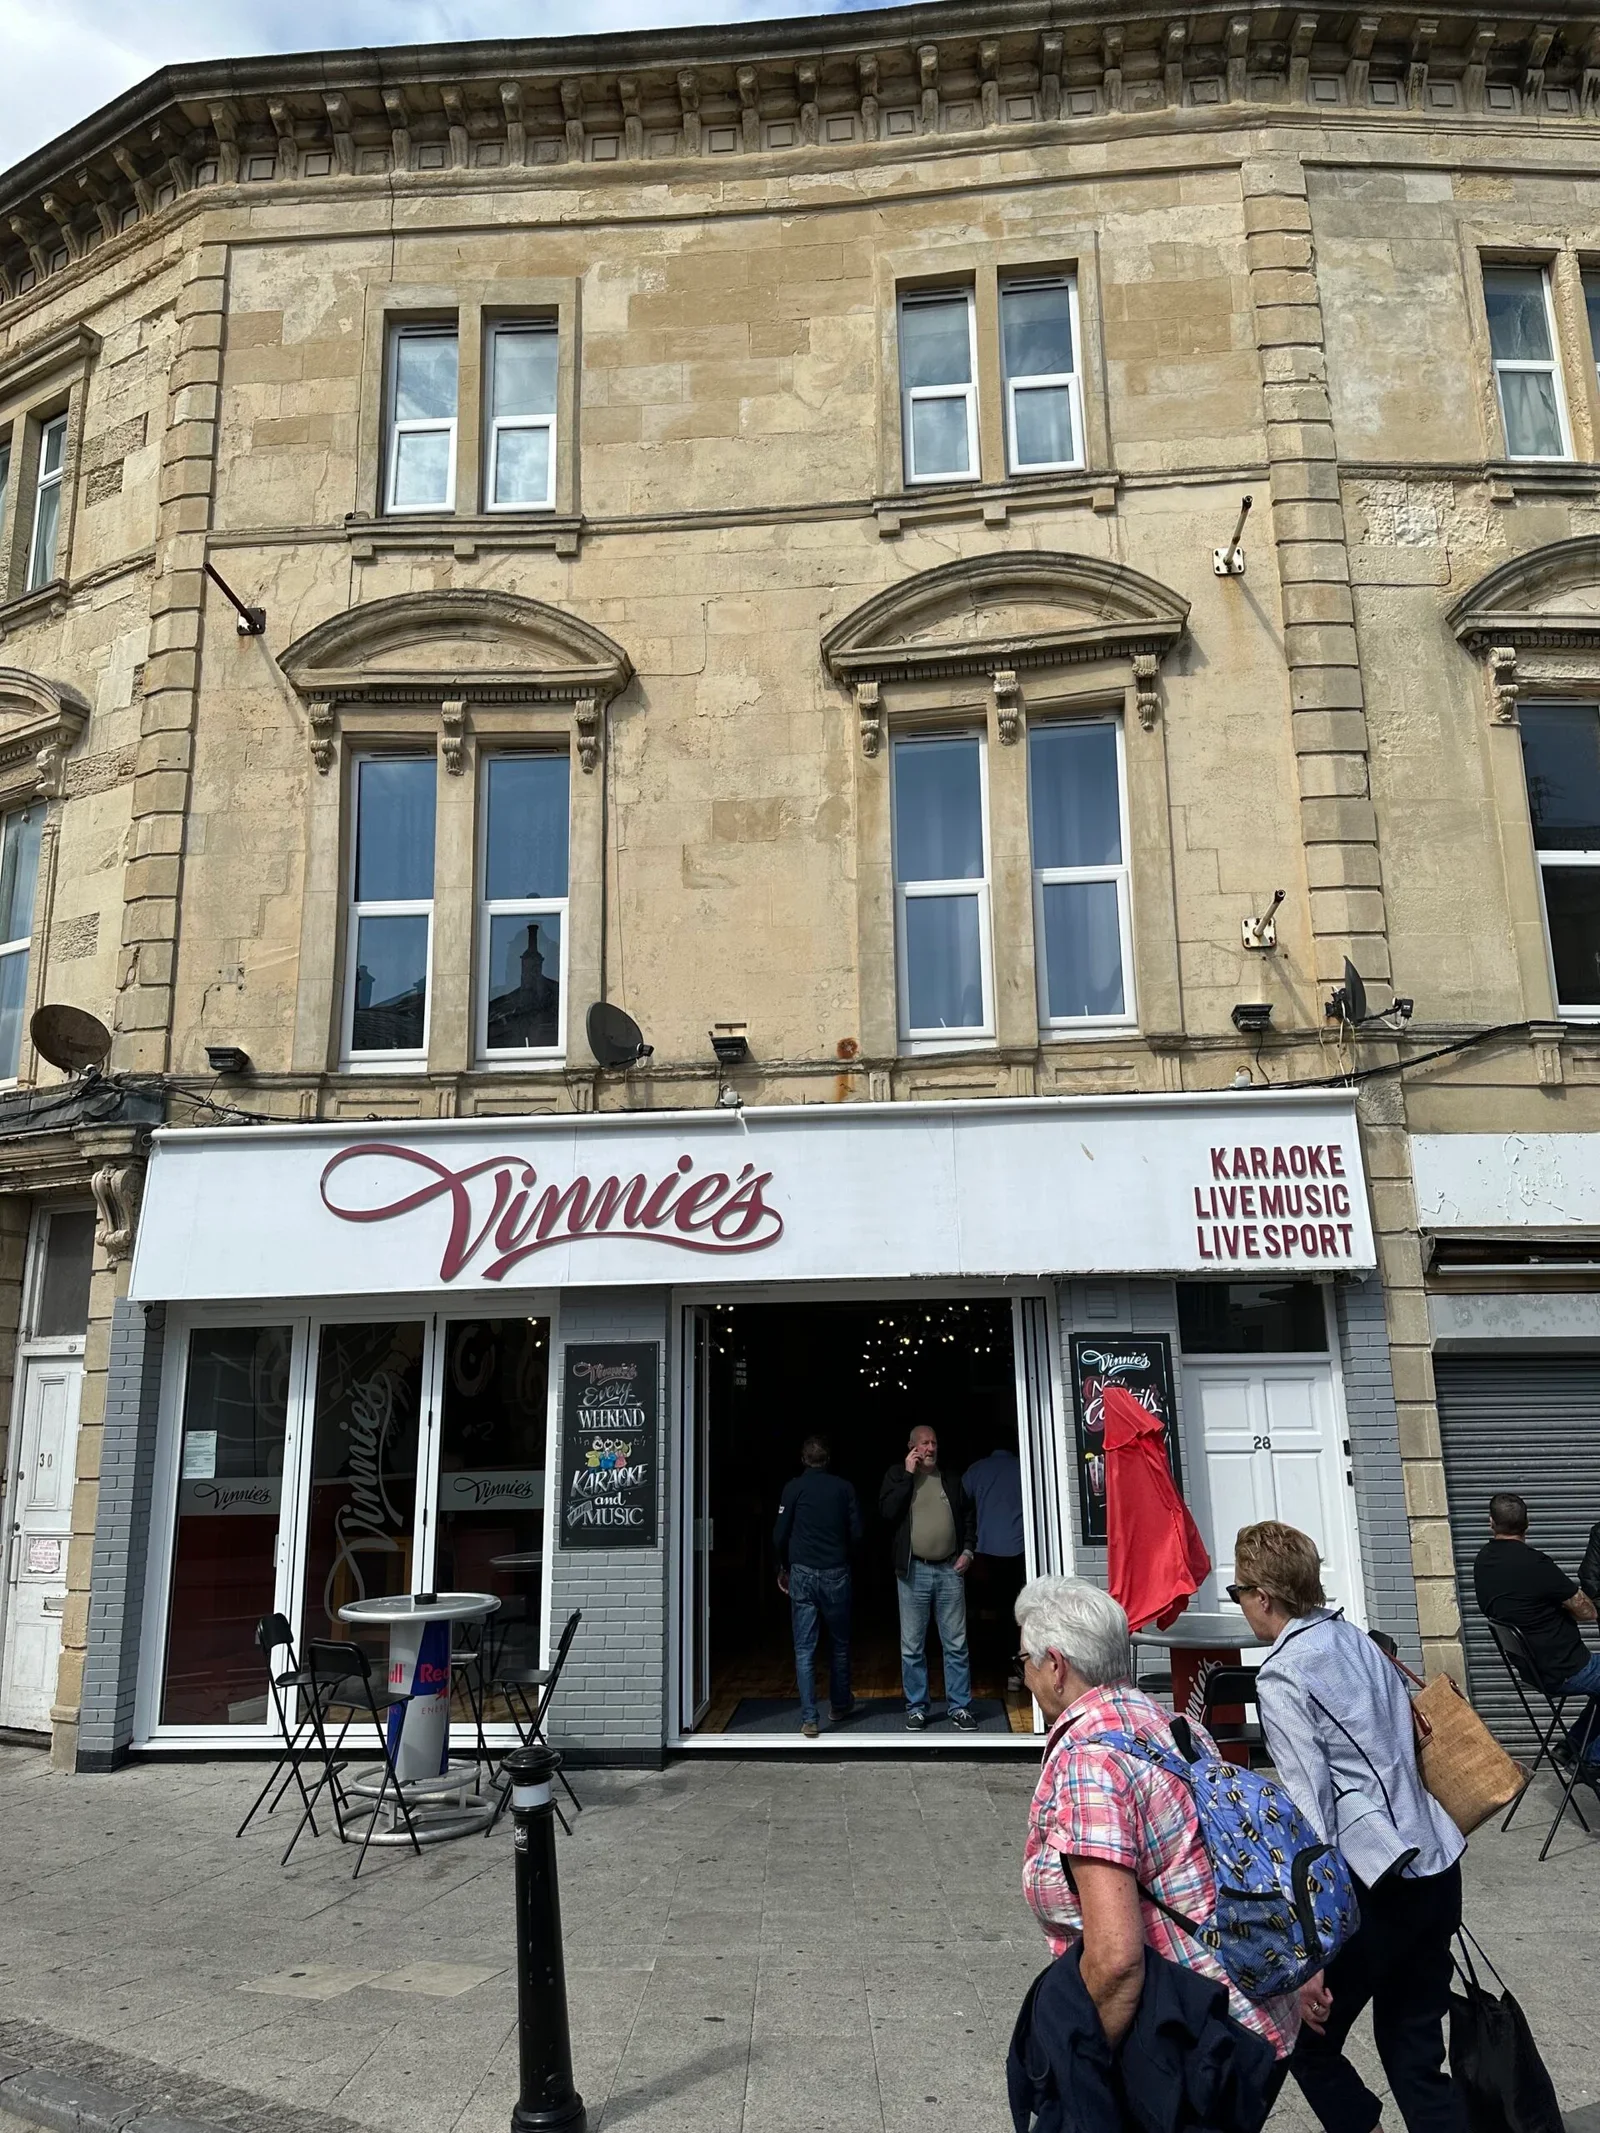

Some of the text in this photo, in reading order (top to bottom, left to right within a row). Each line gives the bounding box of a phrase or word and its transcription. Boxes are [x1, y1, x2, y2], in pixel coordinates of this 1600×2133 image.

[1210, 1145, 1346, 1180] KARAOKE
[320, 1143, 784, 1282] Vinnie's
[1194, 1183, 1350, 1219] LIVE MUSIC
[1197, 1223, 1353, 1259] LIVE SPORT
[1081, 1349, 1151, 1376] Vinnie's
[582, 1382, 633, 1406] Every
[577, 1408, 646, 1429] WEEKEND
[1253, 1435, 1271, 1450] 28
[39, 1453, 53, 1468] 30
[453, 1477, 534, 1505] Vinnie's
[570, 1463, 649, 1498] KARAOKE
[193, 1483, 272, 1511] Vinnie's
[323, 1372, 404, 1624] Vinnie's
[594, 1492, 626, 1506] and
[582, 1507, 644, 1526] MUSIC
